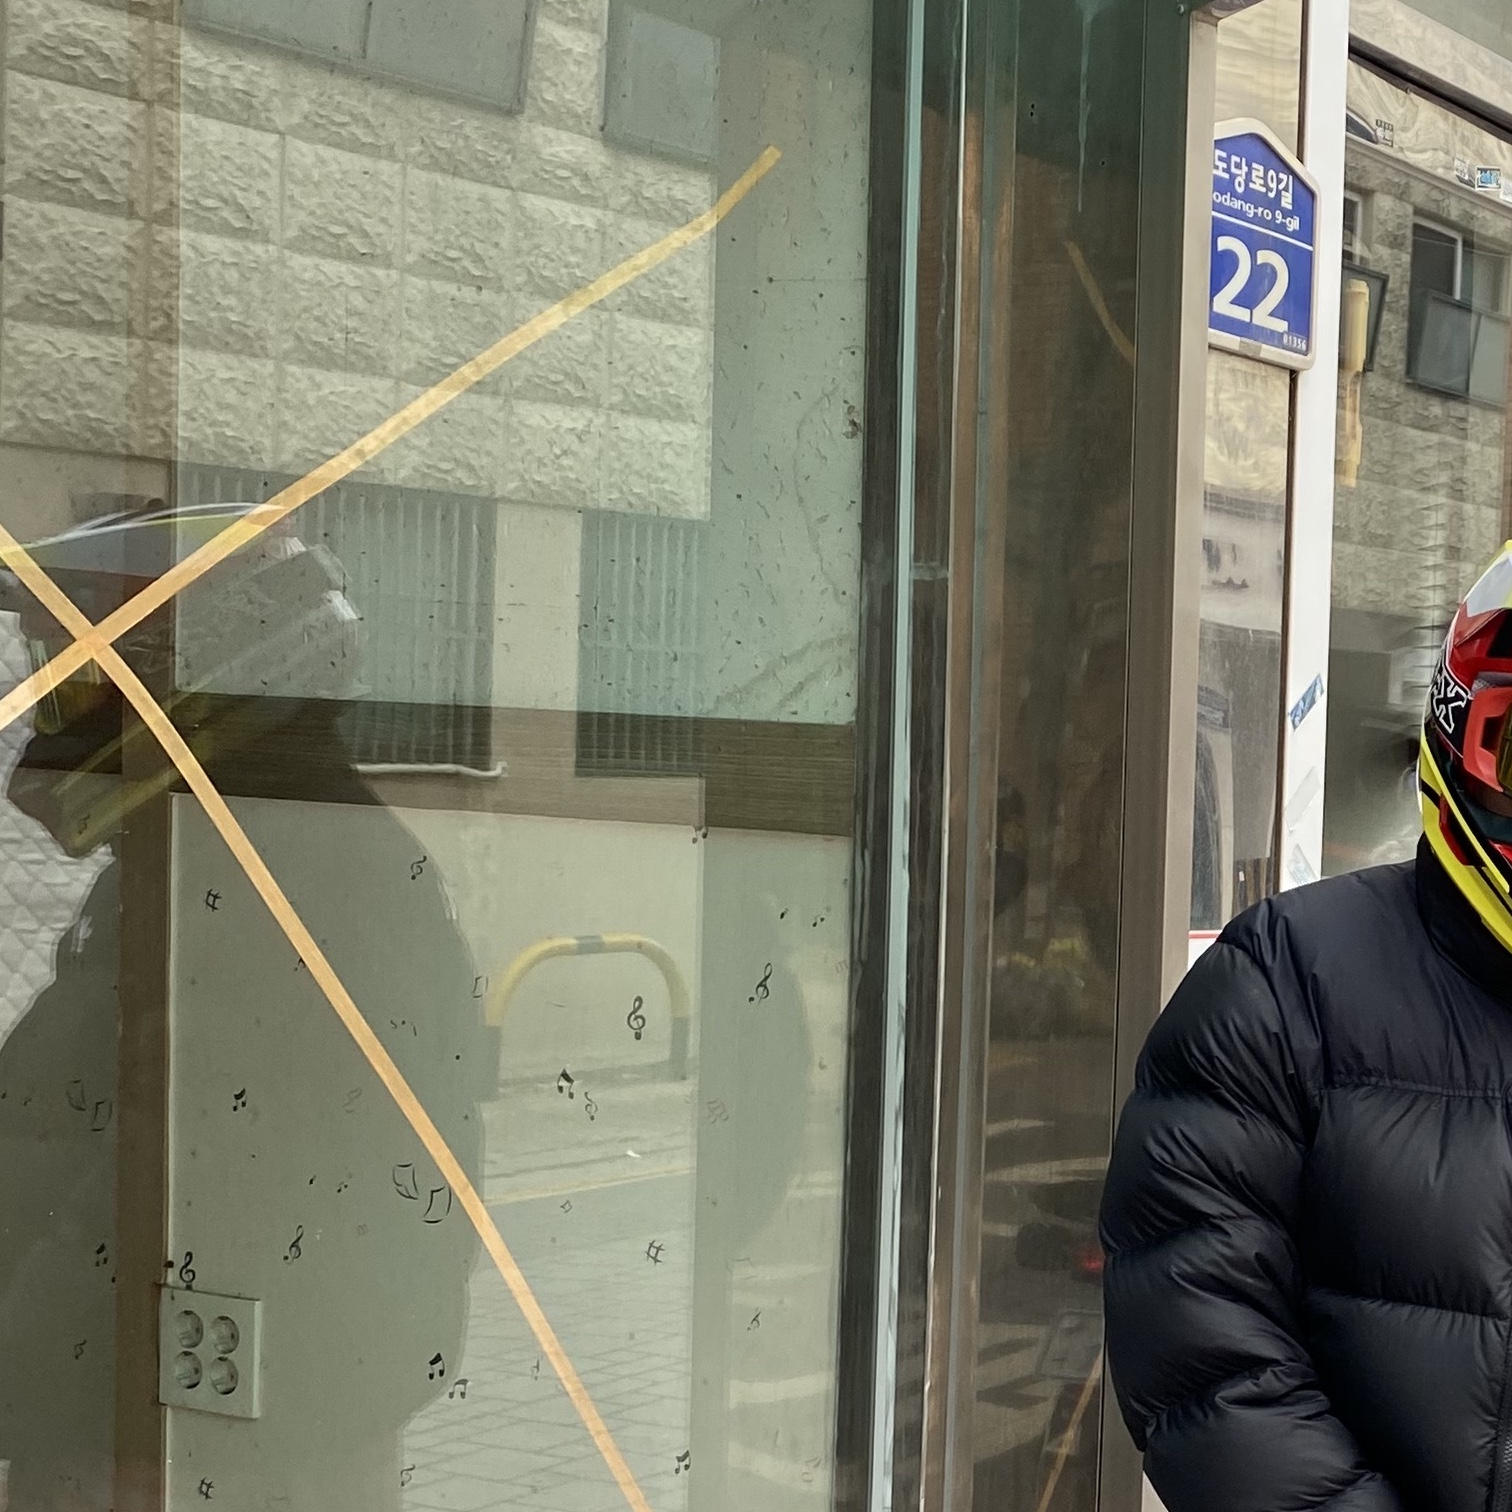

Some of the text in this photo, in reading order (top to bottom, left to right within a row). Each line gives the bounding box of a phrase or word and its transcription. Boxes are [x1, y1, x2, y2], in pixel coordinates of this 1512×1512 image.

[1213, 149, 1294, 210] 도당로9길
[1213, 191, 1300, 231] odang-ro 9-gil
[1212, 236, 1289, 332] 22
